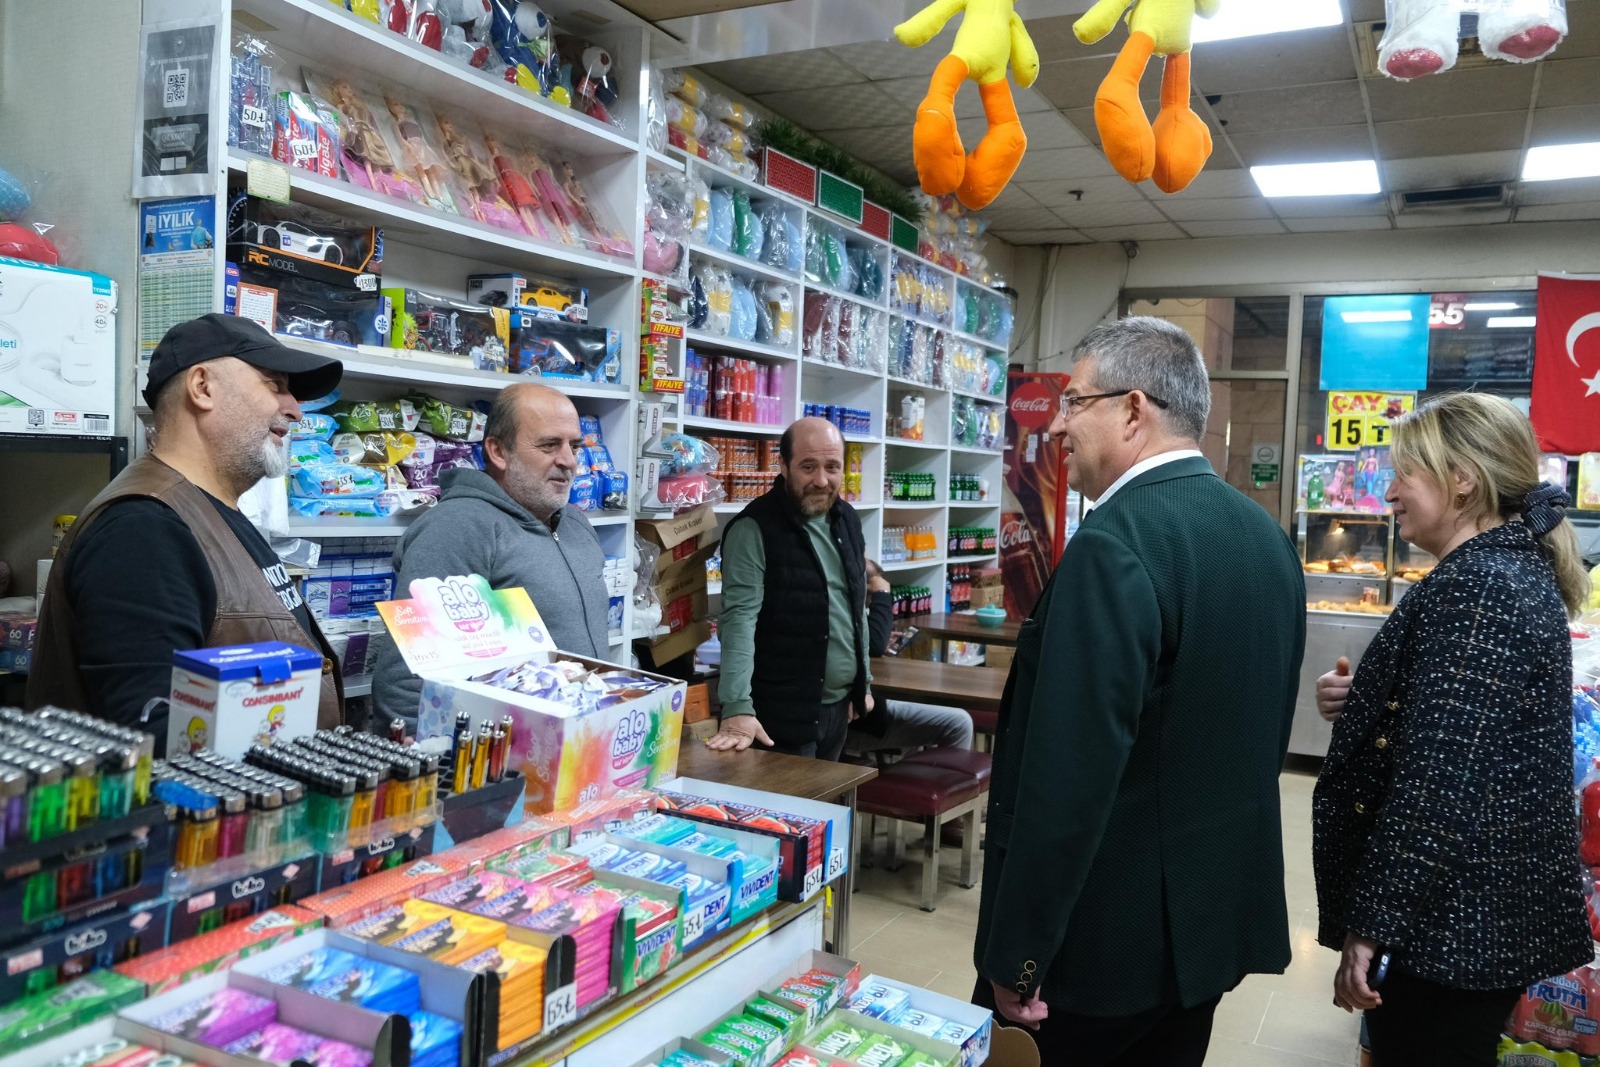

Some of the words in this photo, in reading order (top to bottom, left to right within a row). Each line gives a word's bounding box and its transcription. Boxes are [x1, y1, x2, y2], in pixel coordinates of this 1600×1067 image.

[249, 250, 270, 267] RC
[269, 257, 297, 272] MODEL
[1428, 303, 1465, 325] 55
[1331, 393, 1384, 414] ÇAY
[1331, 418, 1362, 446] 15
[414, 469, 428, 481] 20
[438, 579, 481, 607] alo
[443, 600, 490, 622] baby
[617, 709, 647, 740] alo
[612, 731, 647, 758] baby
[739, 868, 775, 900] VIVIDENT
[637, 923, 678, 957] VIVIDENT
